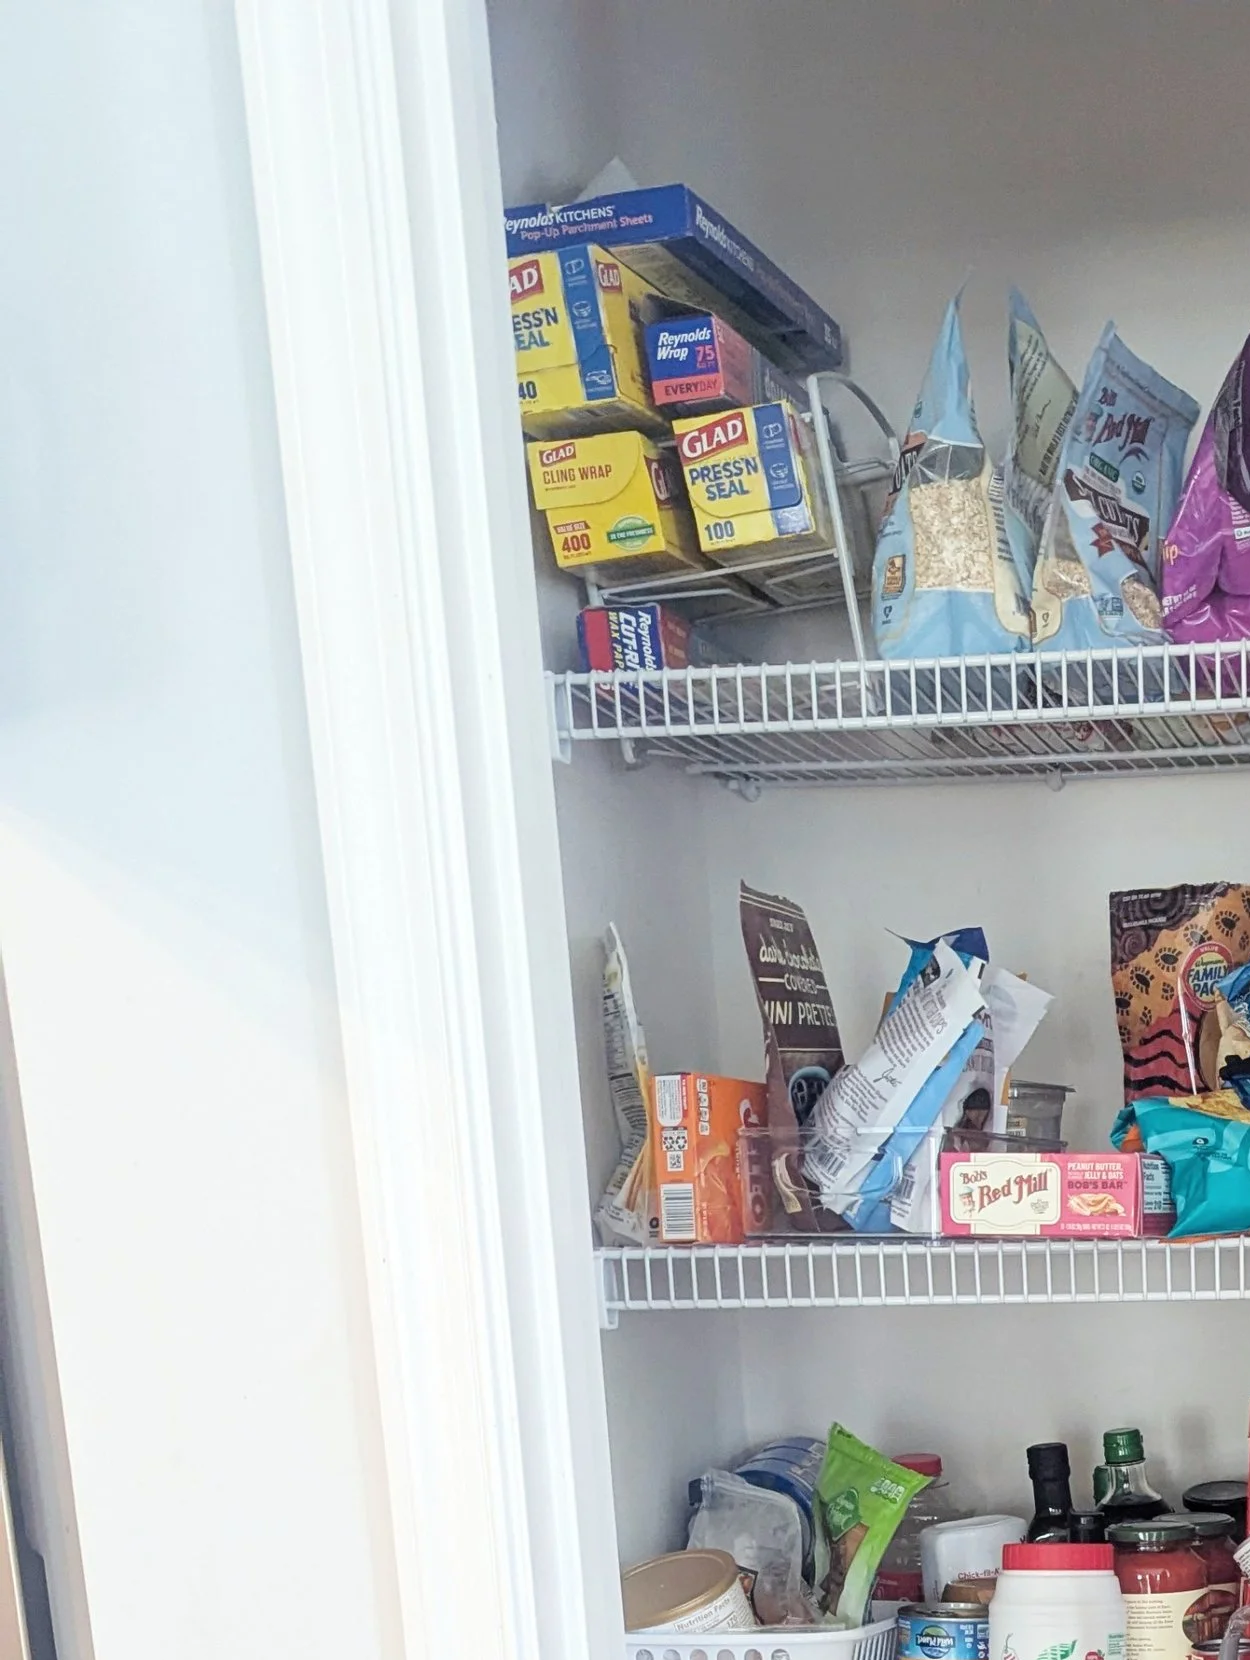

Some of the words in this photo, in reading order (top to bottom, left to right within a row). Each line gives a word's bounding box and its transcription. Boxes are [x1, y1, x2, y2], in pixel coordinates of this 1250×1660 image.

[502, 213, 554, 234] eynolds
[555, 206, 614, 224] KITCHENS
[520, 225, 561, 240] Pop-Up
[562, 218, 617, 236] Parchment
[619, 212, 653, 227] Sheets
[600, 263, 620, 287] GLAD
[658, 326, 712, 347] Reynolds
[656, 346, 689, 361] Wrap
[695, 345, 715, 361] 75
[664, 378, 719, 397] EVERYDAY
[681, 418, 743, 459] GLAD
[541, 444, 575, 465] GLAD
[543, 468, 576, 486] CLING
[578, 464, 612, 481] WRAP
[688, 456, 759, 486] PRESS'N
[705, 479, 750, 501] SEAL
[704, 520, 736, 541] 100
[562, 532, 592, 553] 400
[608, 611, 620, 640] WAX
[618, 612, 641, 676] CUT-RI
[637, 610, 658, 671] Reynolds
[1067, 1162, 1094, 1171] PEANUT
[1083, 1171, 1101, 1181] JELLY
[1101, 1171, 1107, 1180] &
[1107, 1171, 1124, 1180] OATS
[960, 1170, 988, 1185] Bob's
[1067, 1181, 1100, 1190] BOB'S
[1101, 1181, 1123, 1190] BAR
[977, 1183, 1012, 1213] Red
[1012, 1168, 1049, 1204] Mill
[677, 1611, 714, 1632] Nutrition
